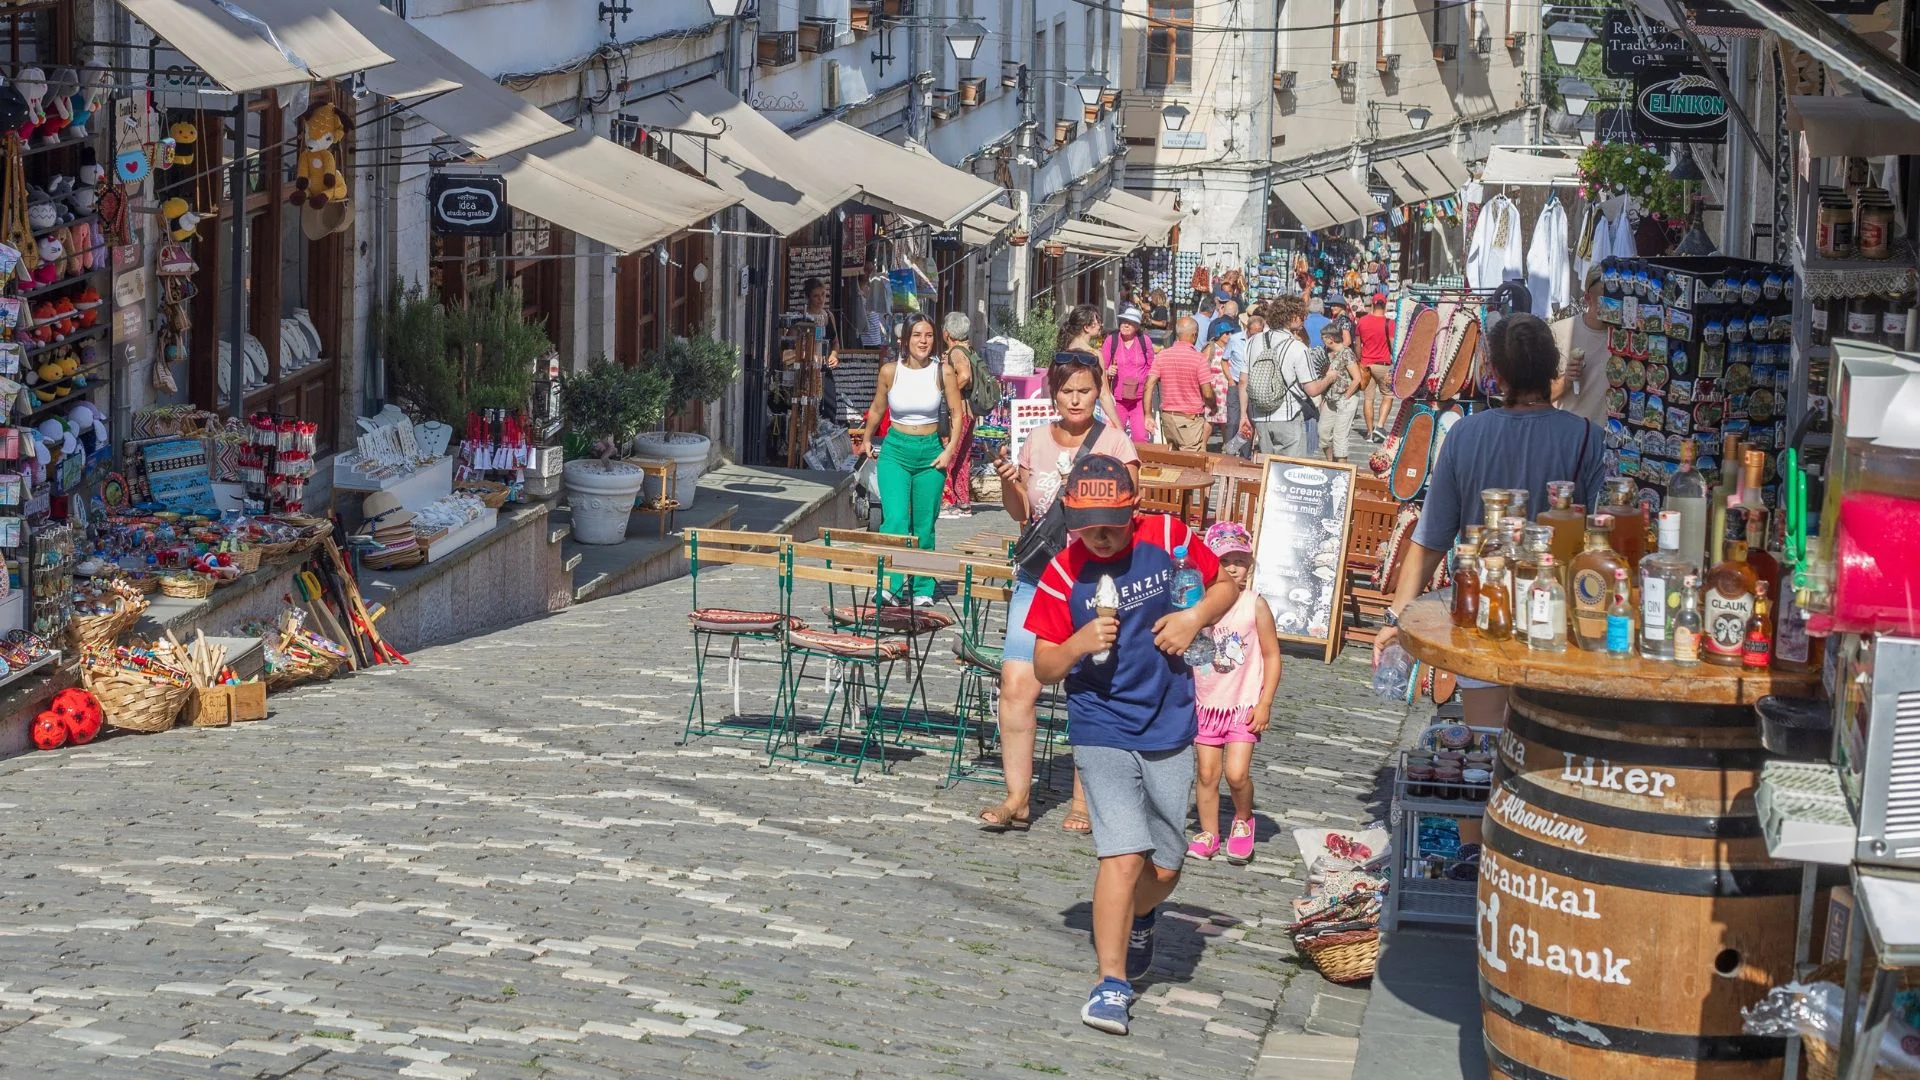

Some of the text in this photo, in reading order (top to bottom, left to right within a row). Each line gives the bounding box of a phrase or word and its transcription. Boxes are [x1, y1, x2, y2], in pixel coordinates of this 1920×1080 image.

[1649, 93, 1726, 115] ELINIKON
[458, 200, 477, 210] idea
[1287, 471, 1325, 481] ELINIKON
[1080, 482, 1114, 498] DUDE
[1289, 486, 1322, 497] cream
[1647, 600, 1660, 612] GIN
[1711, 599, 1748, 612] GLAUK
[1560, 751, 1676, 797] Liker
[1497, 795, 1587, 846] Albanian
[1509, 923, 1631, 985] Glauk
